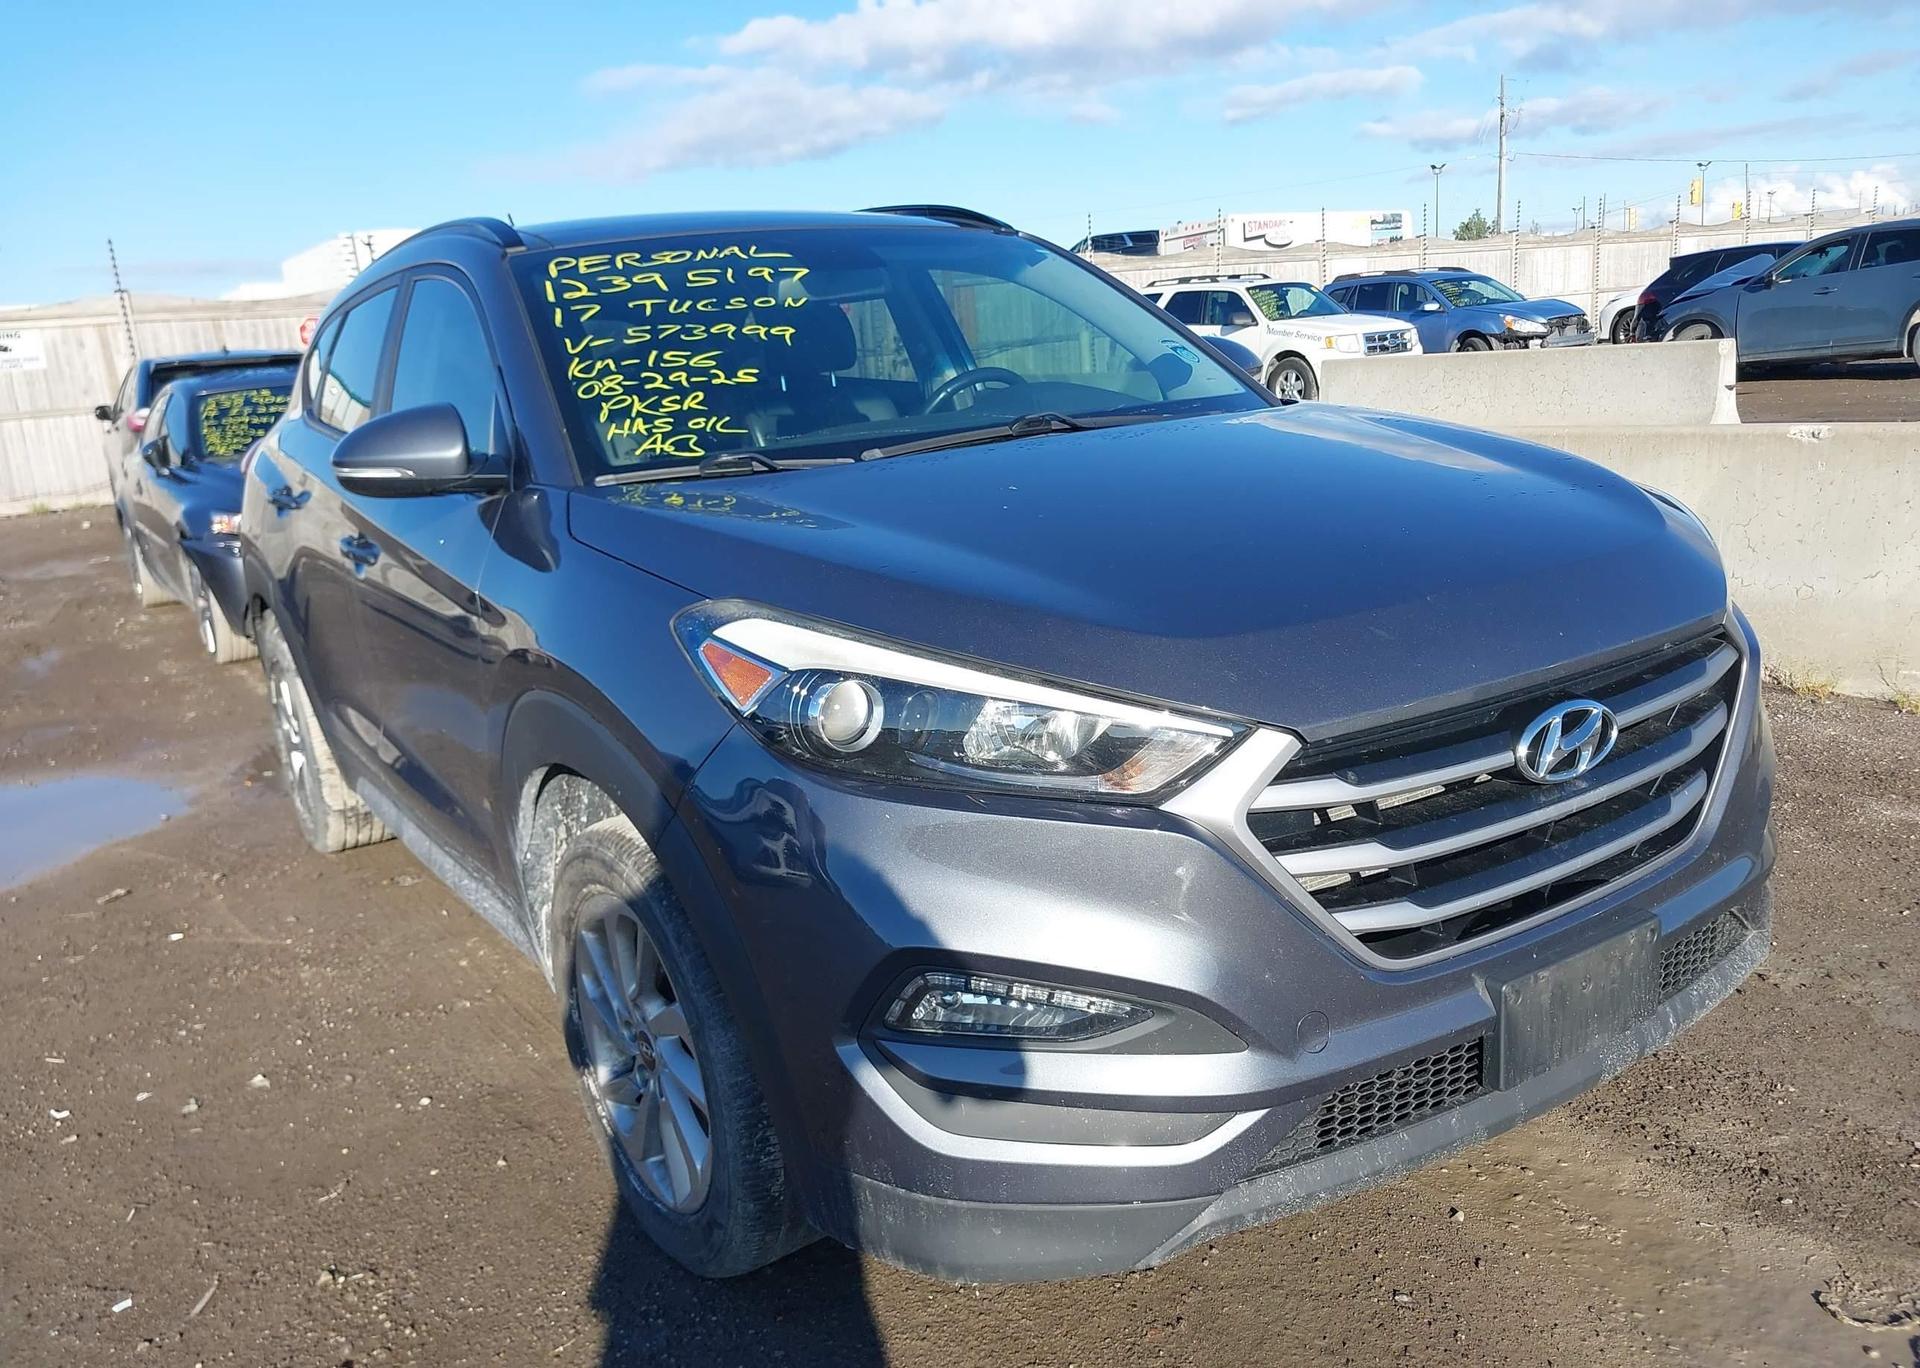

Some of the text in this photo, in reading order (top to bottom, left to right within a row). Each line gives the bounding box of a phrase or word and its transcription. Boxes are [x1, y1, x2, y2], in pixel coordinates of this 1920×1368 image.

[547, 245, 793, 278] PERSONAL
[553, 296, 809, 328] 17 TUCSON
[1265, 327, 1322, 342] Member Service
[576, 368, 760, 399] 08-29-25
[607, 416, 749, 442] HAS OIL
